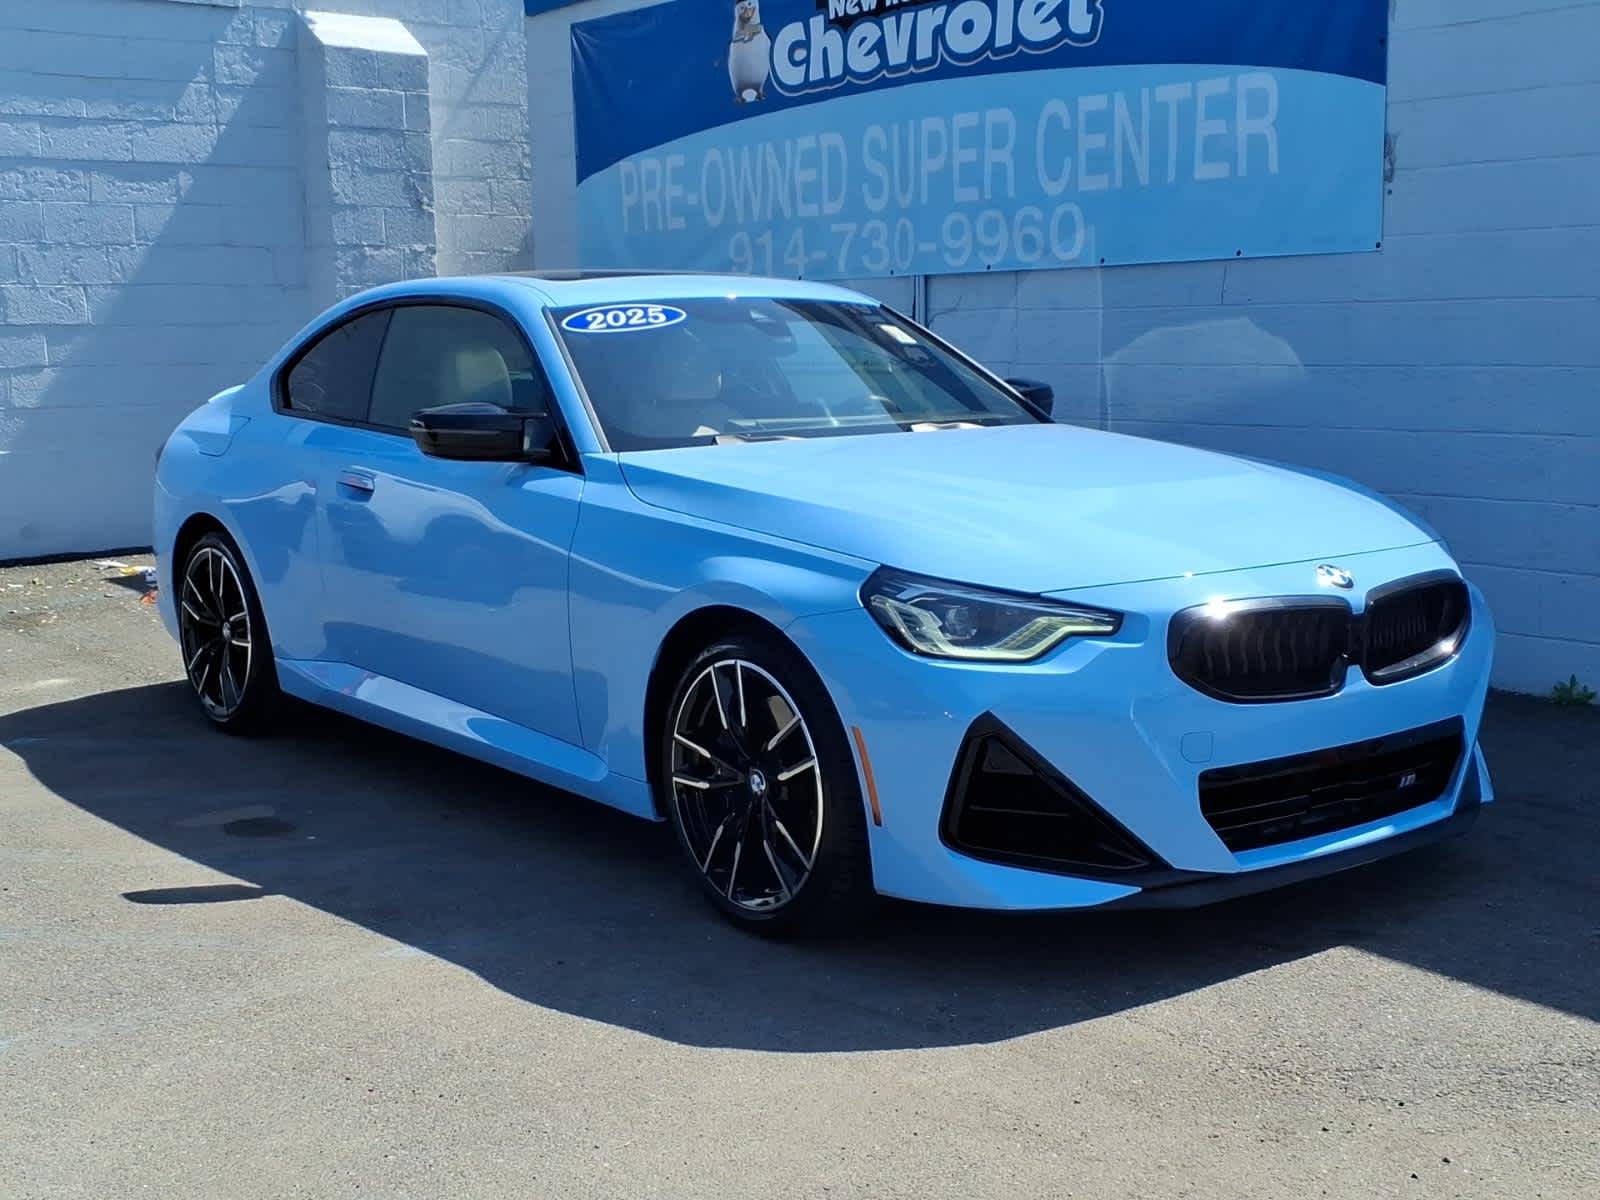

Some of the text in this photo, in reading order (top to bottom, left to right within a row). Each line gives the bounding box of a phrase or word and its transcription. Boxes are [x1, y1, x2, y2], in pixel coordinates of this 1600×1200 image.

[619, 71, 1280, 233] PRE-OWNED SUPER CENTER
[728, 202, 1085, 277] 914-730-9960
[585, 307, 667, 330] 2025
